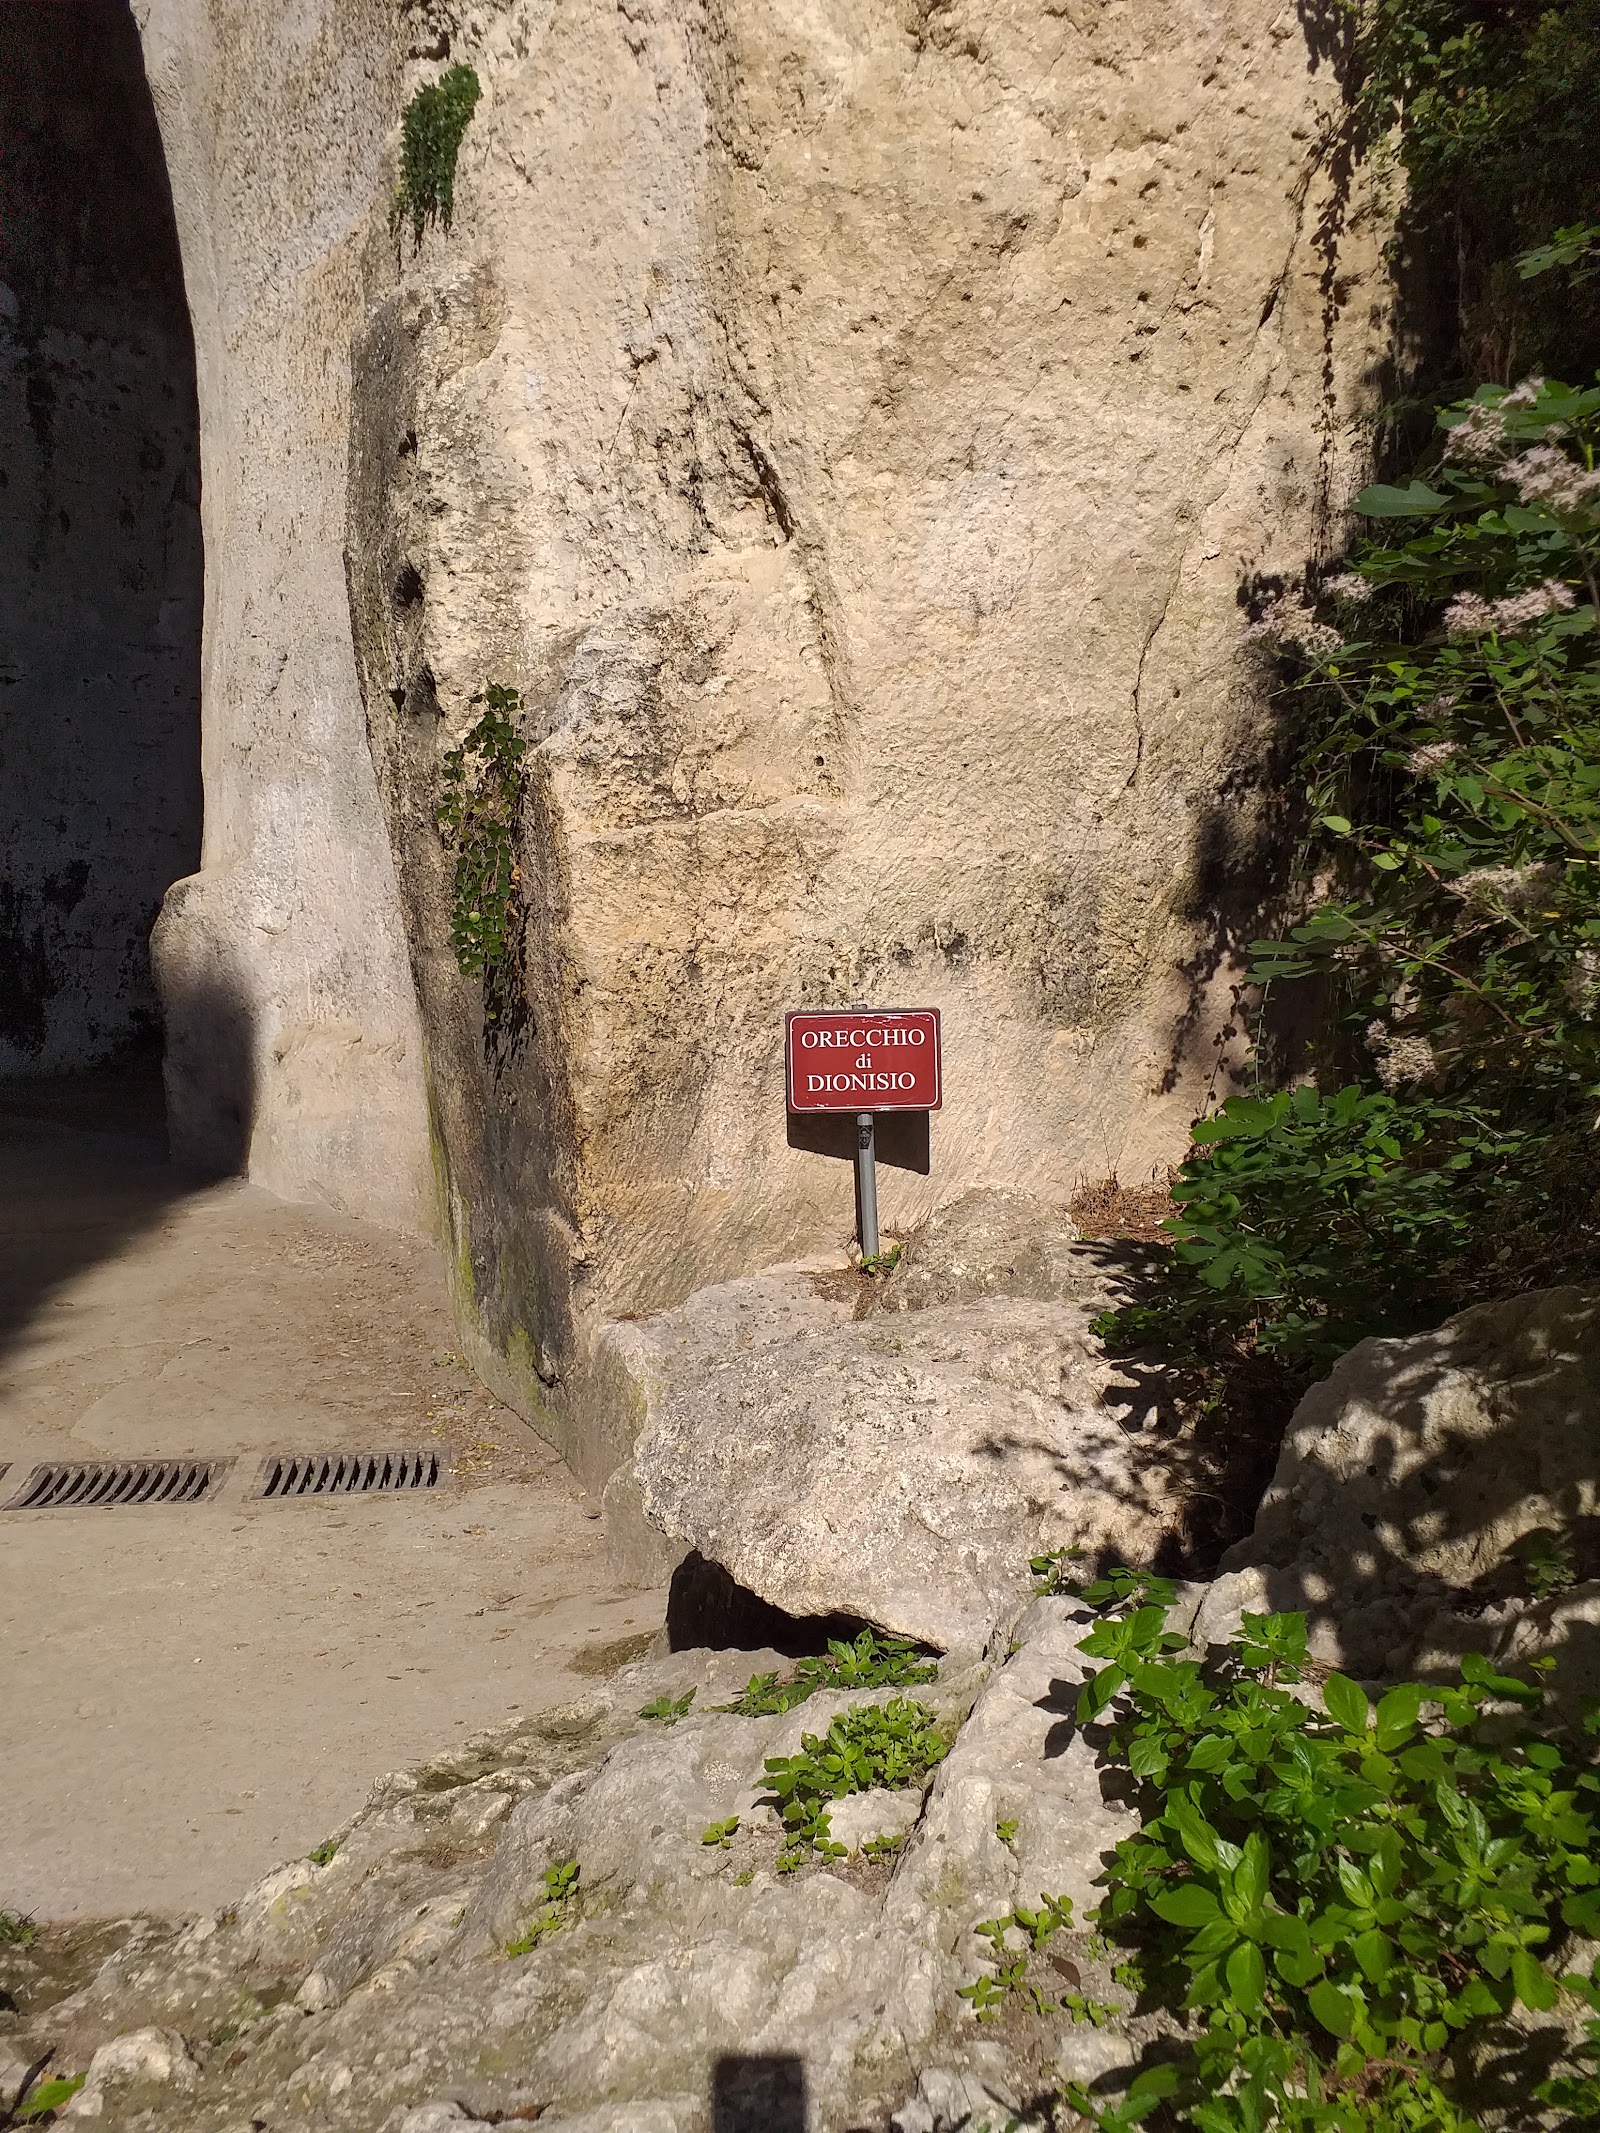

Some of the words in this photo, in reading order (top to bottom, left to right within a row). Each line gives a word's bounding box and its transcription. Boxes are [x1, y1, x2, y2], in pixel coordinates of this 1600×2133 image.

[801, 1028, 925, 1048] ORECCHIO
[855, 1053, 872, 1069] di
[807, 1072, 916, 1092] DIONISIO
